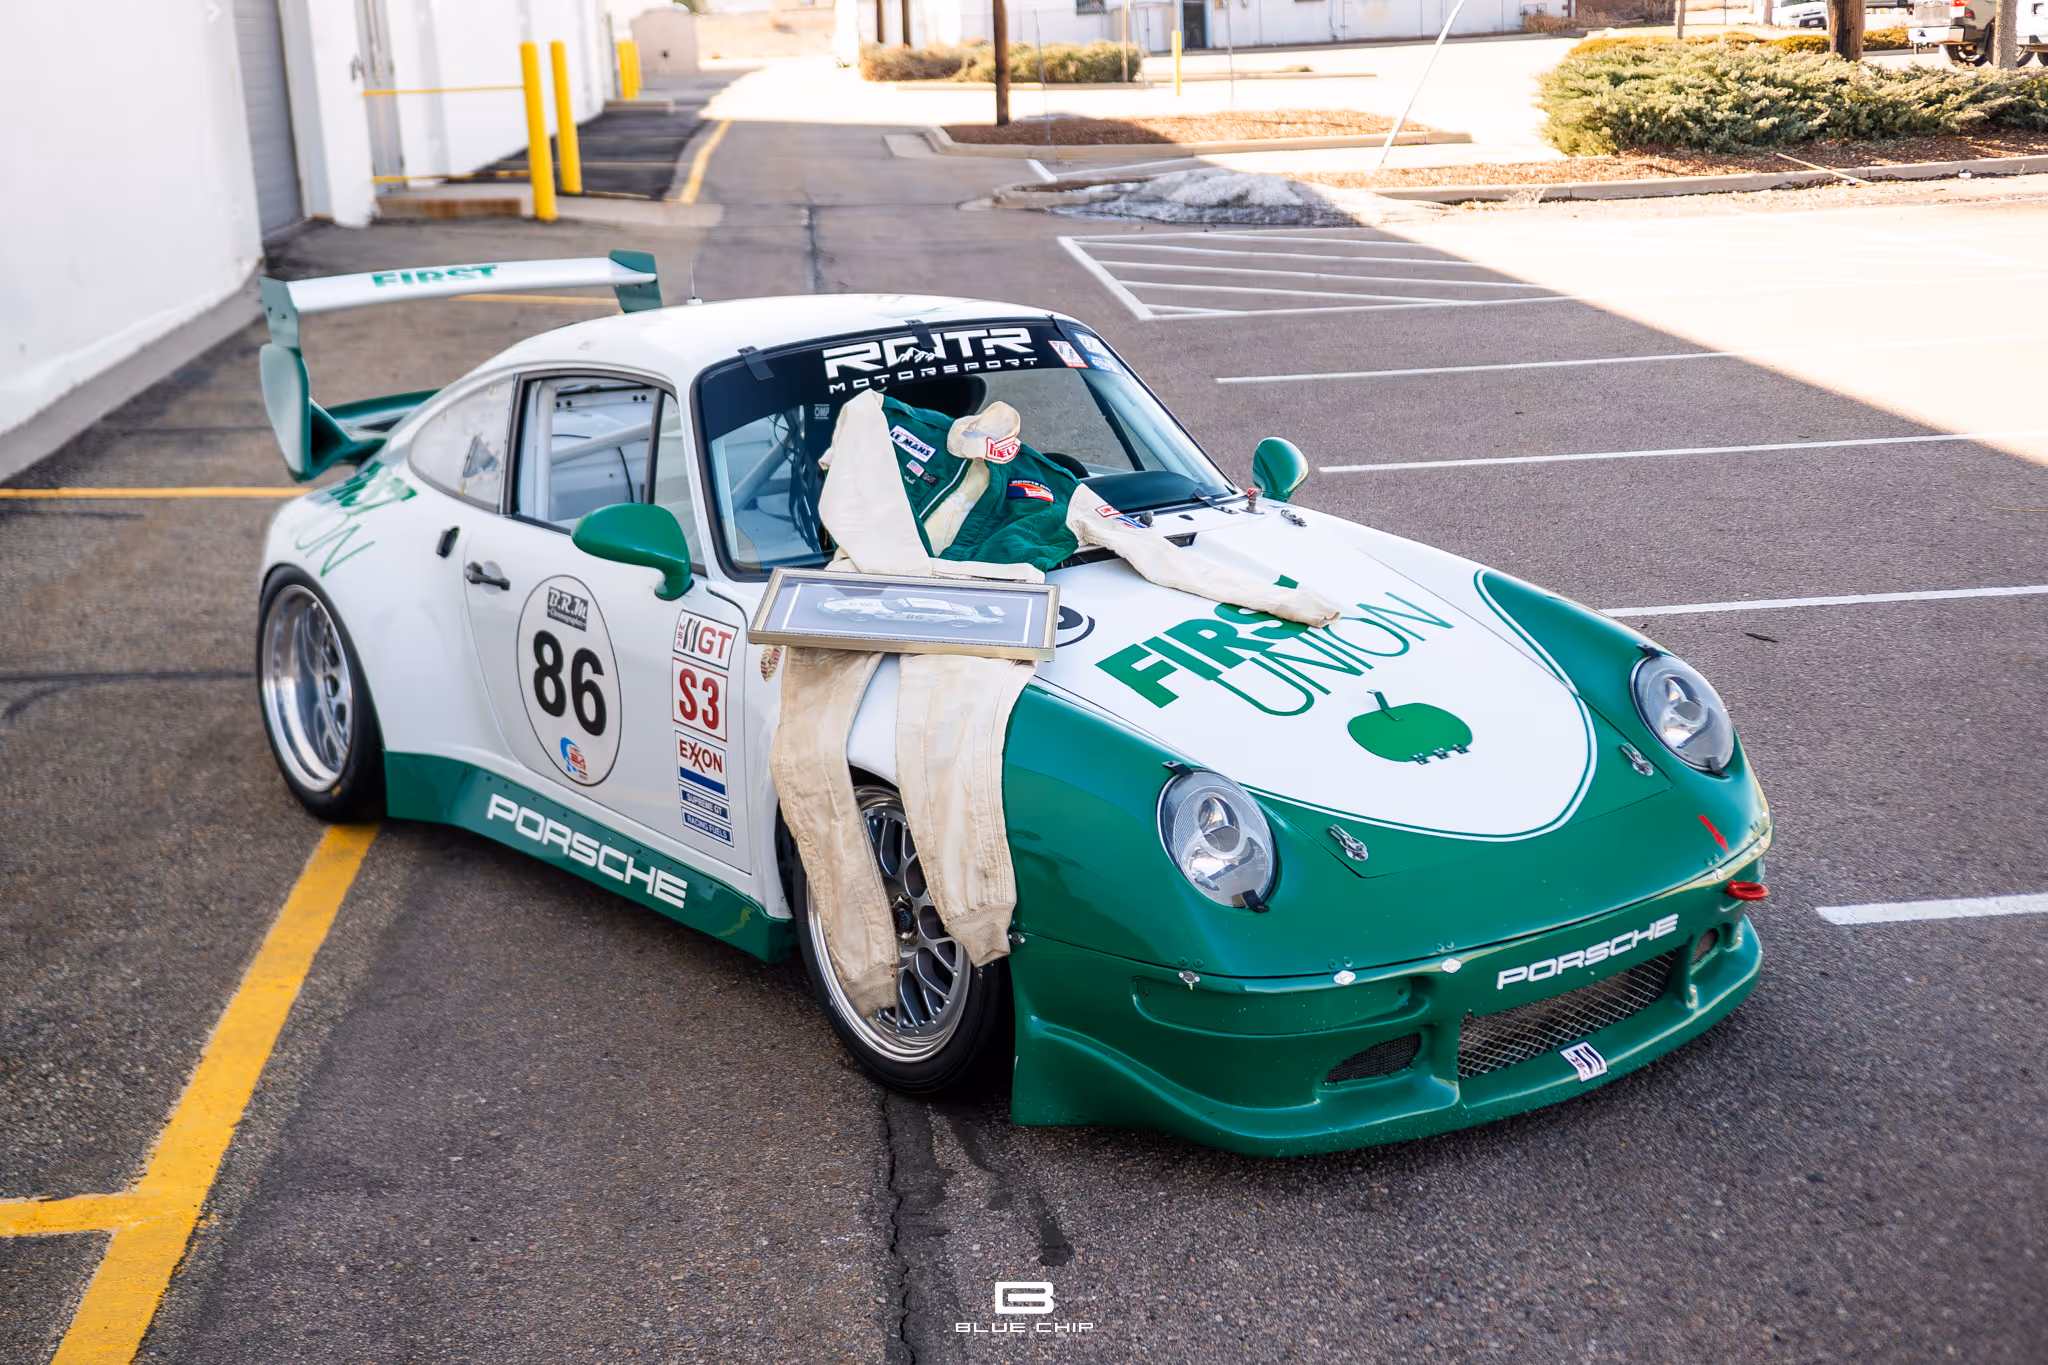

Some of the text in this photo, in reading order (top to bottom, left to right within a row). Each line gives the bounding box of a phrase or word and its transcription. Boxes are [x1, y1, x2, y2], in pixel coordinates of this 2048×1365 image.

[372, 264, 498, 288] FIRST
[828, 357, 1038, 394] MOTORSPORT
[814, 406, 830, 418] OMP
[902, 438, 931, 456] MANS
[697, 626, 733, 660] GT
[1095, 574, 1310, 708] FIRS
[1212, 592, 1455, 716] UNION
[533, 629, 607, 737] 86
[679, 668, 720, 730] S3
[679, 738, 723, 773] EXXON
[686, 792, 713, 813] SUPREME
[686, 814, 728, 840] RACING FUELS
[487, 793, 688, 909] PORSCHE
[1496, 912, 1680, 991] PORSCHE
